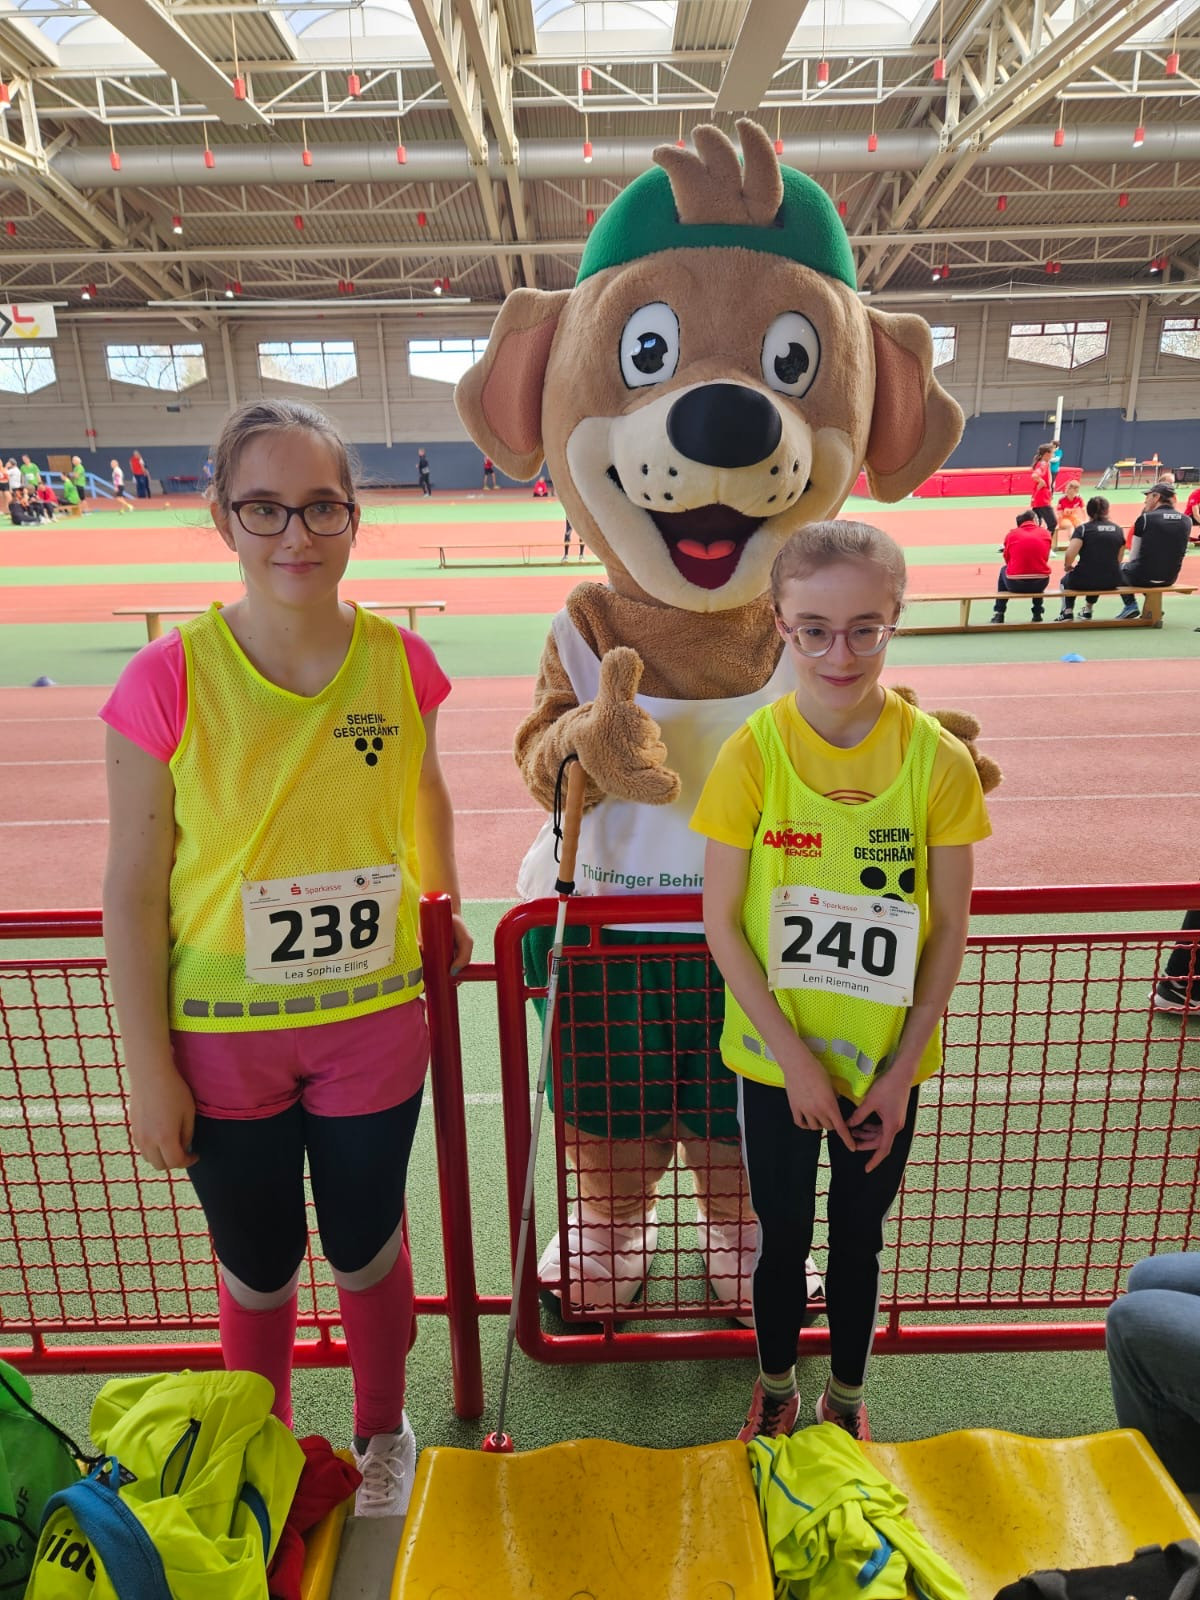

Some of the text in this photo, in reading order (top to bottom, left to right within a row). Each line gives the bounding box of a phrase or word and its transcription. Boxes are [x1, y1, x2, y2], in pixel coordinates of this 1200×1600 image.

[347, 713, 386, 725] SEHEIN-
[333, 724, 400, 738] GESCHRÄNKT
[869, 828, 914, 843] SEHEIN-
[582, 863, 654, 889] Thüringer
[305, 884, 342, 895] Sparkasse
[822, 901, 858, 912] Sparkasse
[269, 899, 380, 963] 238
[781, 915, 898, 977] 240
[285, 970, 304, 980] Lea
[306, 964, 342, 978] Sophie
[803, 973, 870, 993] Leni Riemann
